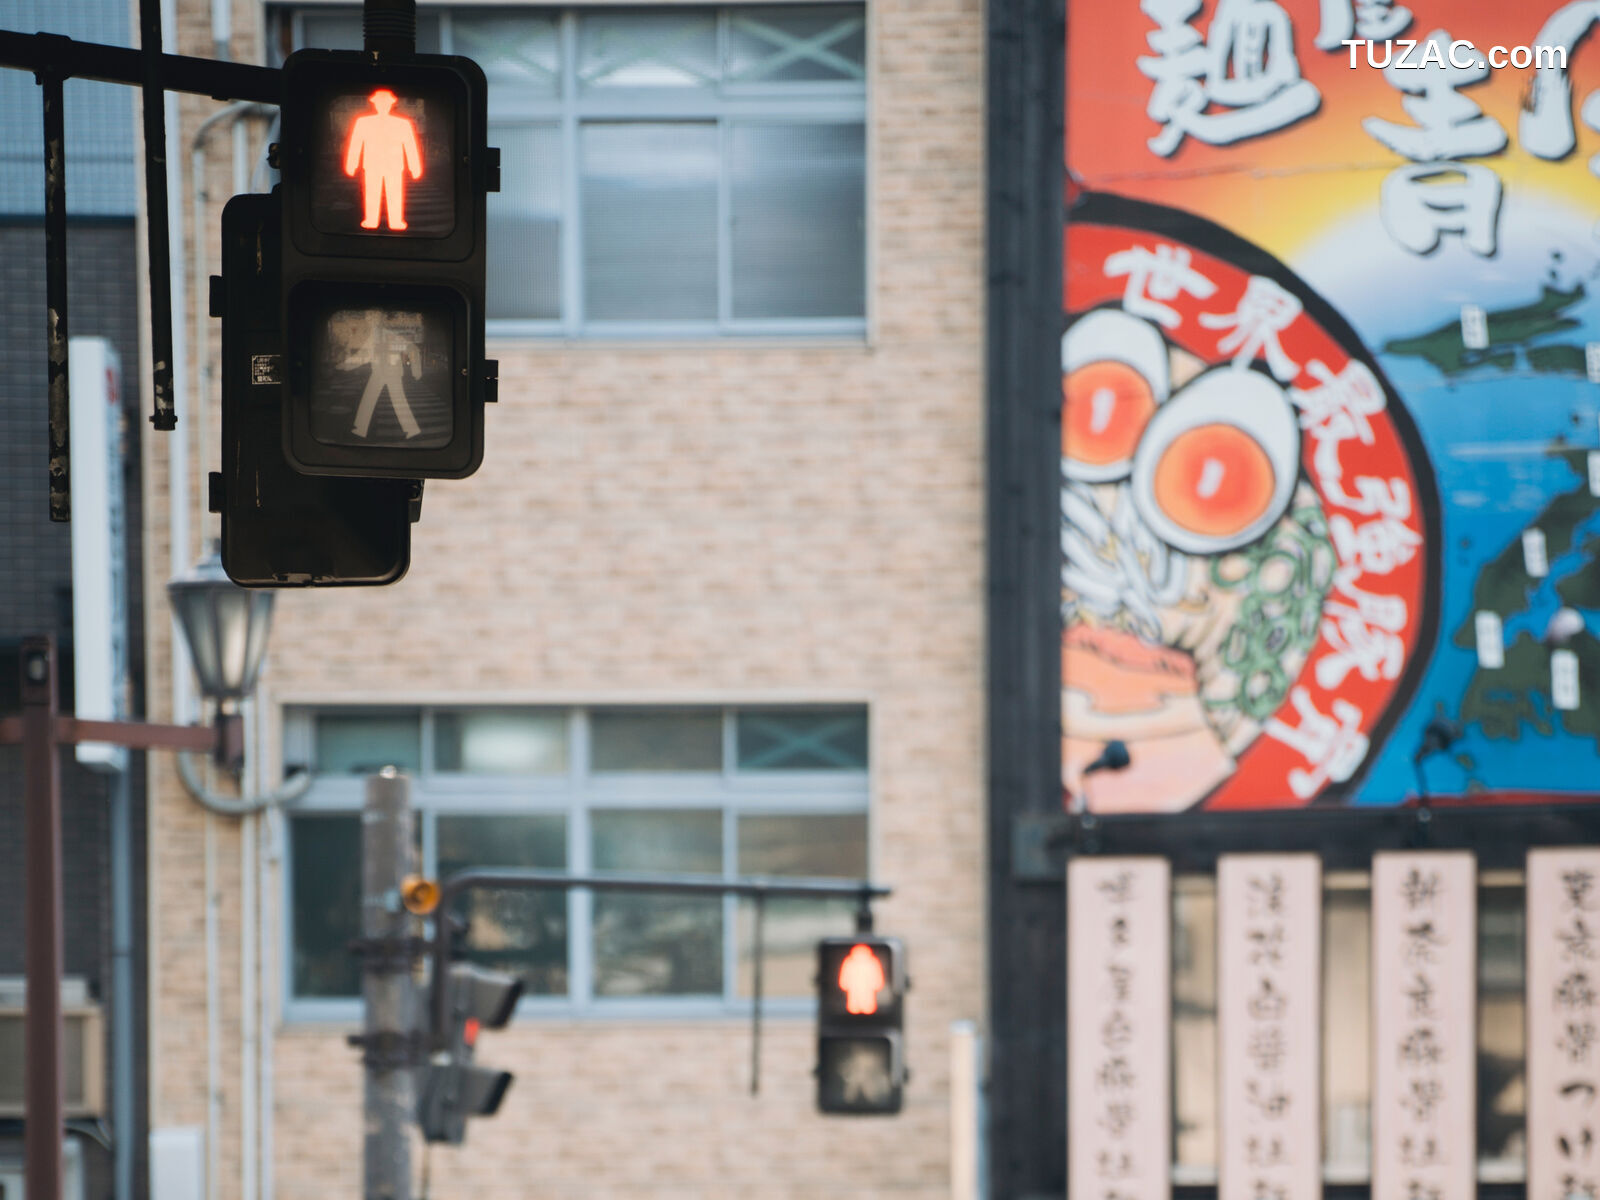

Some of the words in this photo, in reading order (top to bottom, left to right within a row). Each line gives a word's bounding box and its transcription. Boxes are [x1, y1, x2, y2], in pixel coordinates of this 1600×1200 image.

[1104, 245, 1424, 800] 世界最強豚骨
